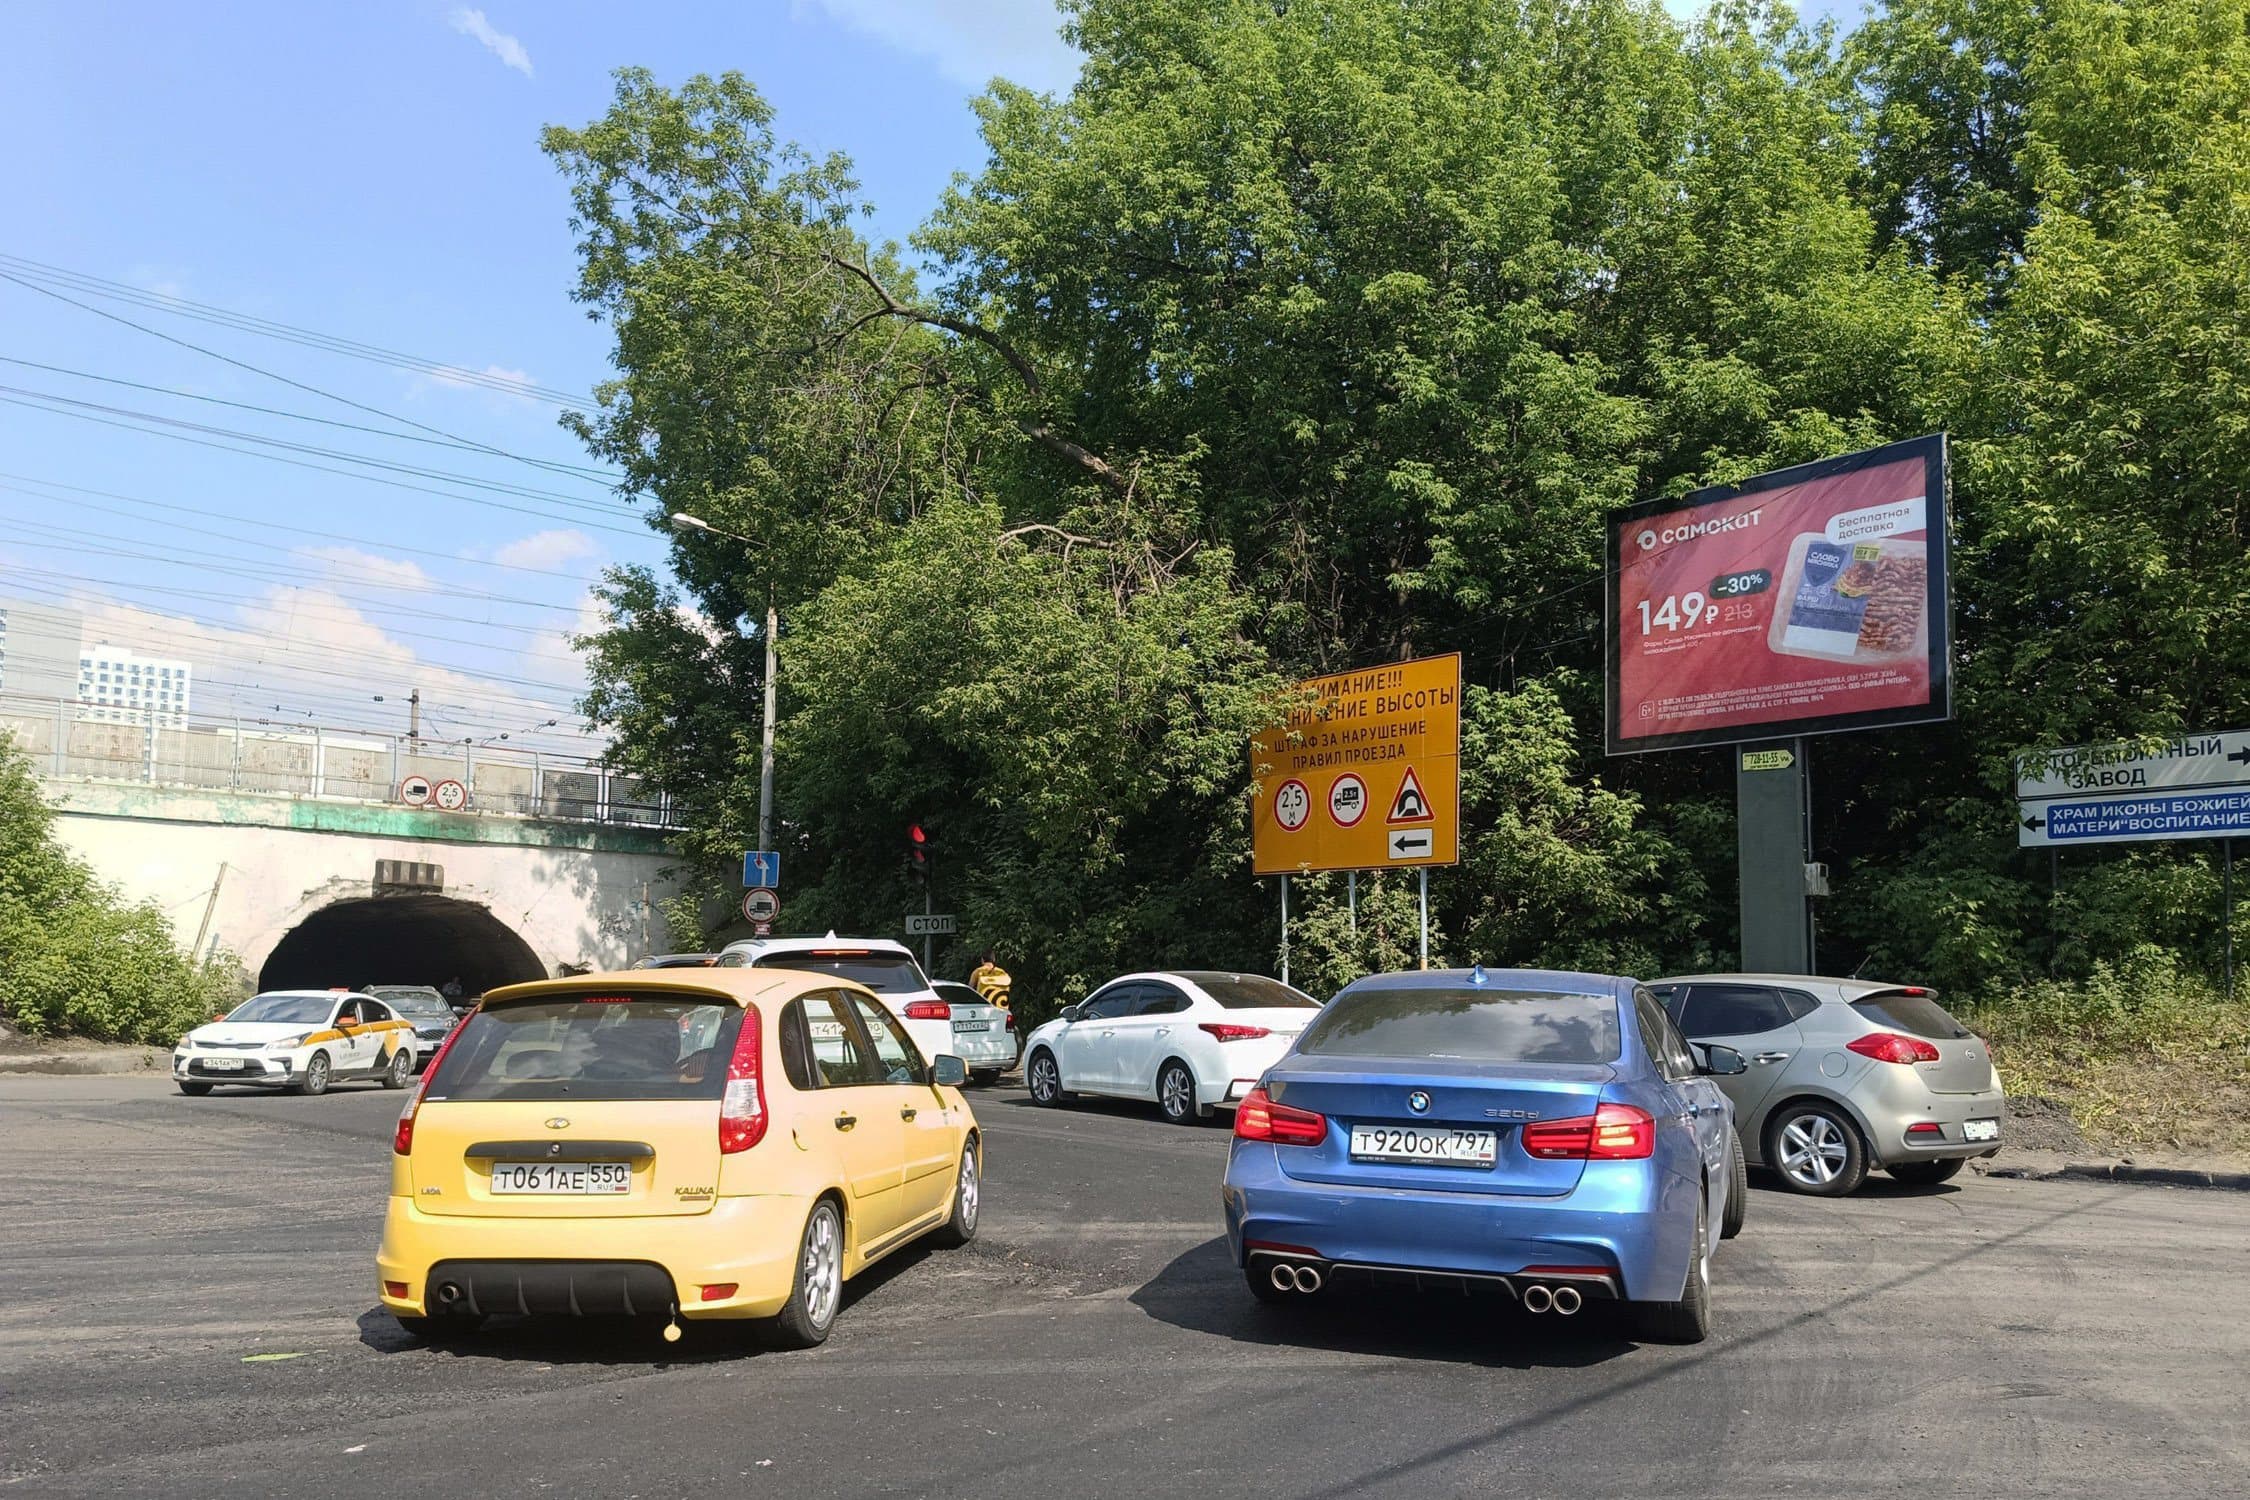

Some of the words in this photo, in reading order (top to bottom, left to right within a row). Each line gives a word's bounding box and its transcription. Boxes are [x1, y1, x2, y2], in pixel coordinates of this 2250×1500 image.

[1661, 509, 1762, 544] самокат
[1838, 508, 1910, 529] Бесплатная
[1838, 521, 1894, 540] доставка
[1717, 573, 1763, 594] -30%
[1724, 603, 1754, 622] 213
[1307, 670, 1402, 701] ИМАНИЕ!!!
[1376, 686, 1454, 715] ВЫСОТЫ
[1321, 733, 1338, 747] ЗА
[1342, 720, 1427, 744] НАРУШЕНИЕ
[1292, 750, 1342, 769] ПРАВИЛ
[1345, 743, 1406, 763] ПРОЕЗДА
[2072, 768, 2146, 790] ЗАВОД
[1281, 789, 1303, 810] 2,5
[2053, 806, 2098, 821] ХРАМ
[2102, 802, 2166, 817] ИКОНЫ
[2172, 795, 2250, 813] БОЖИЕЙ
[913, 917, 950, 931] СТОП
[1453, 1131, 1490, 1151] 797
[590, 1165, 626, 1183] 550
